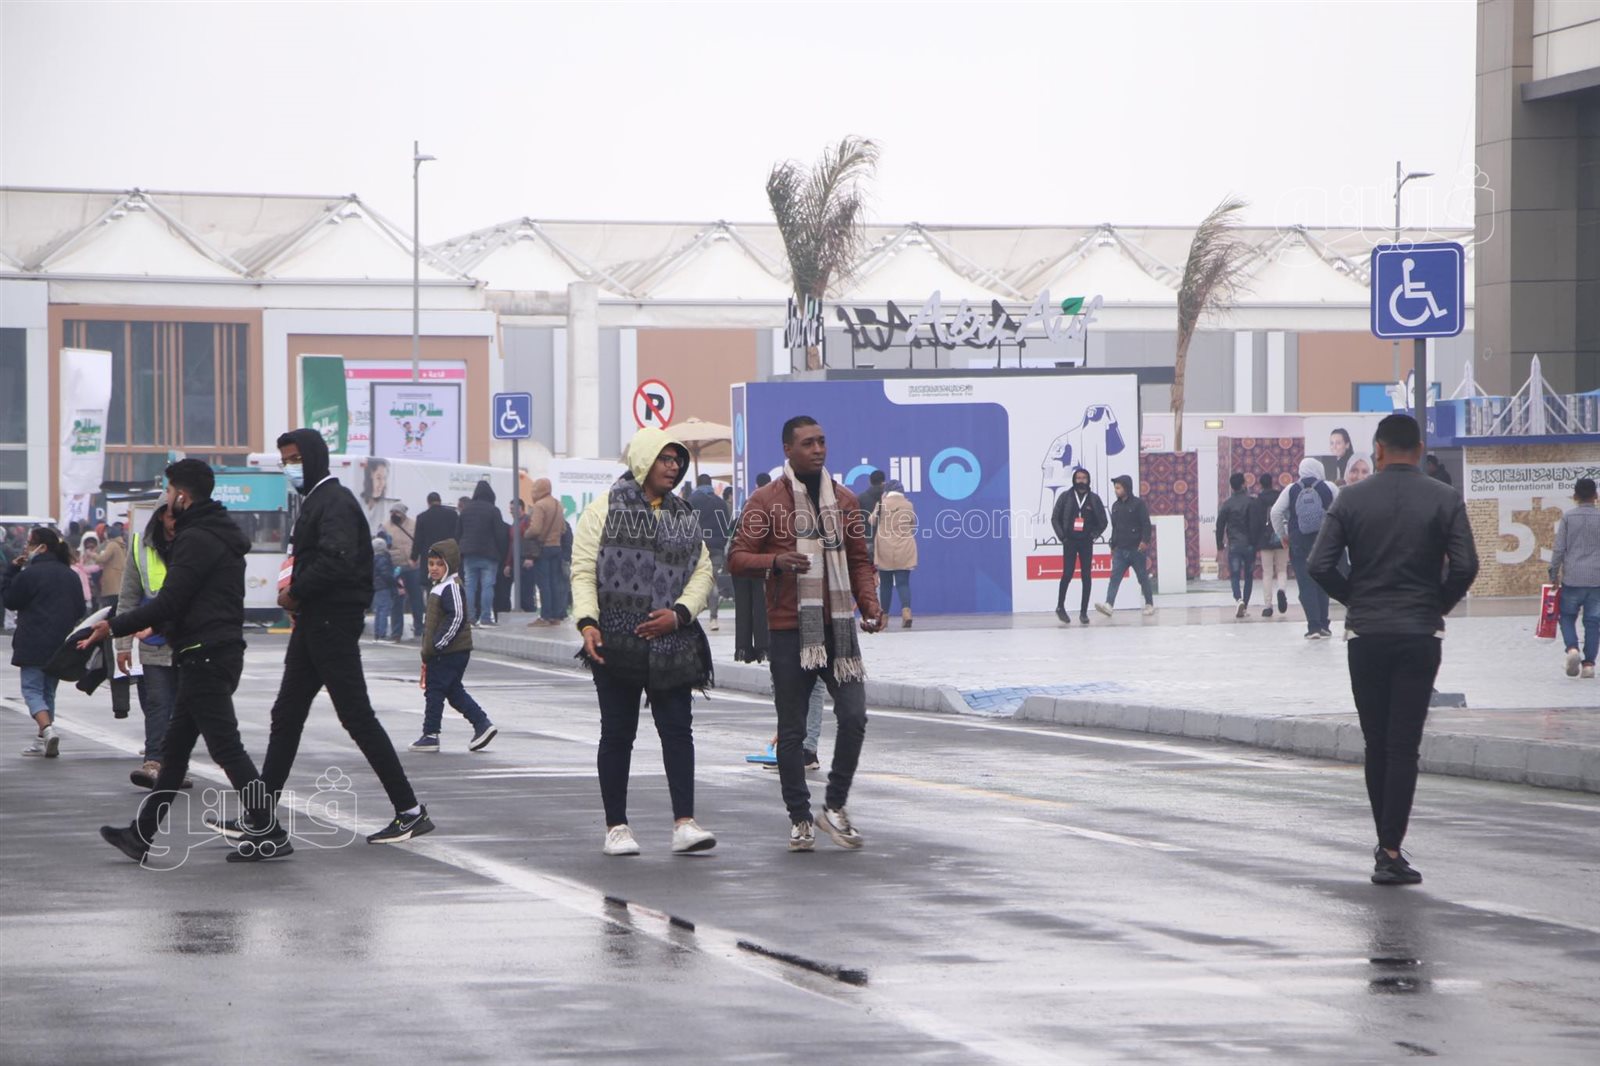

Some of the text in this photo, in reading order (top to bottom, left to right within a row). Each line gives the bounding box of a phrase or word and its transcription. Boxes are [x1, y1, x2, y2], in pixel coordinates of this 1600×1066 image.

[904, 290, 1008, 345] Abu
[1014, 290, 1104, 343] Auf
[645, 393, 665, 421] P
[1471, 481, 1577, 492] Cairo International Boo
